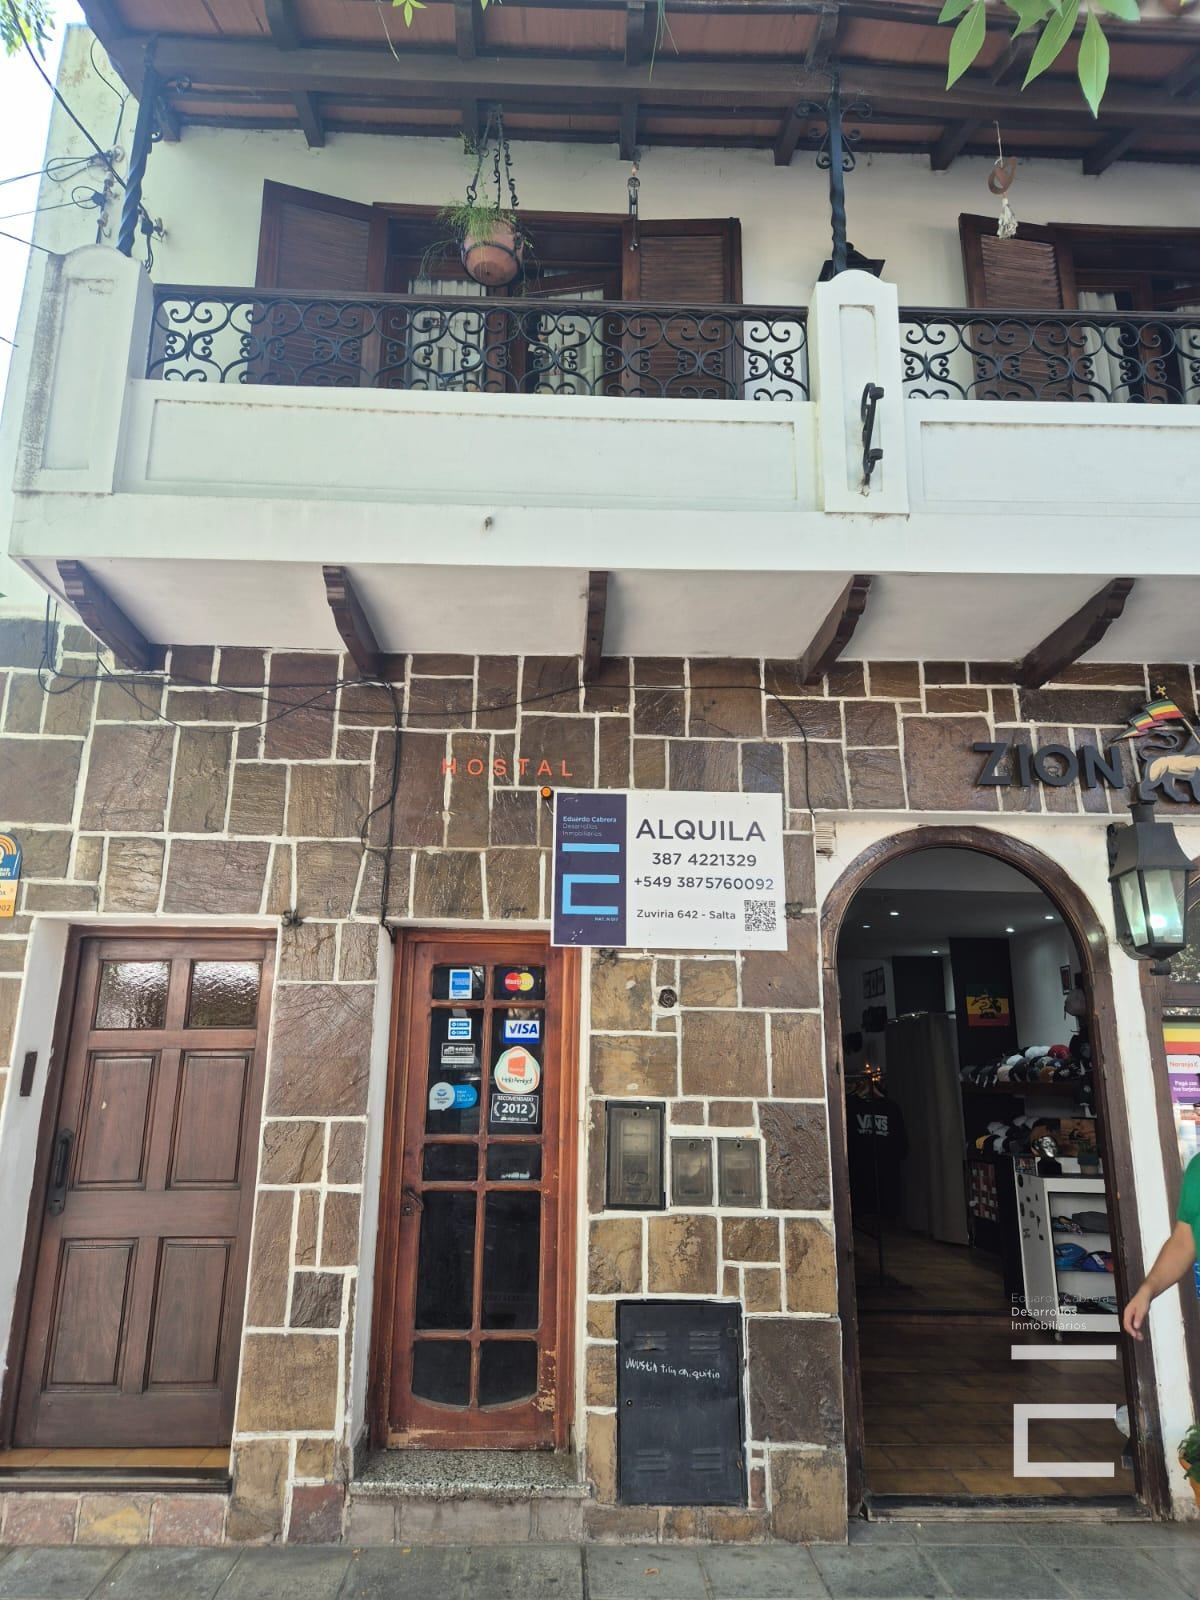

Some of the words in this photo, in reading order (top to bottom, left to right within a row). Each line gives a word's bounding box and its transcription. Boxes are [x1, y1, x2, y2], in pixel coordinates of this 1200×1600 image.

[441, 758, 573, 777] HOSTAL
[973, 742, 1125, 789] ZION
[635, 818, 766, 842] ALQUILA
[652, 852, 682, 866] 387
[688, 853, 757, 867] 4221329
[634, 876, 672, 888] +549
[677, 876, 774, 890] 3875760092
[636, 909, 674, 919] Zuviria
[677, 910, 698, 919] 642
[709, 911, 736, 920] Salta
[509, 1023, 538, 1034] VISA
[501, 1103, 528, 1114] 2012
